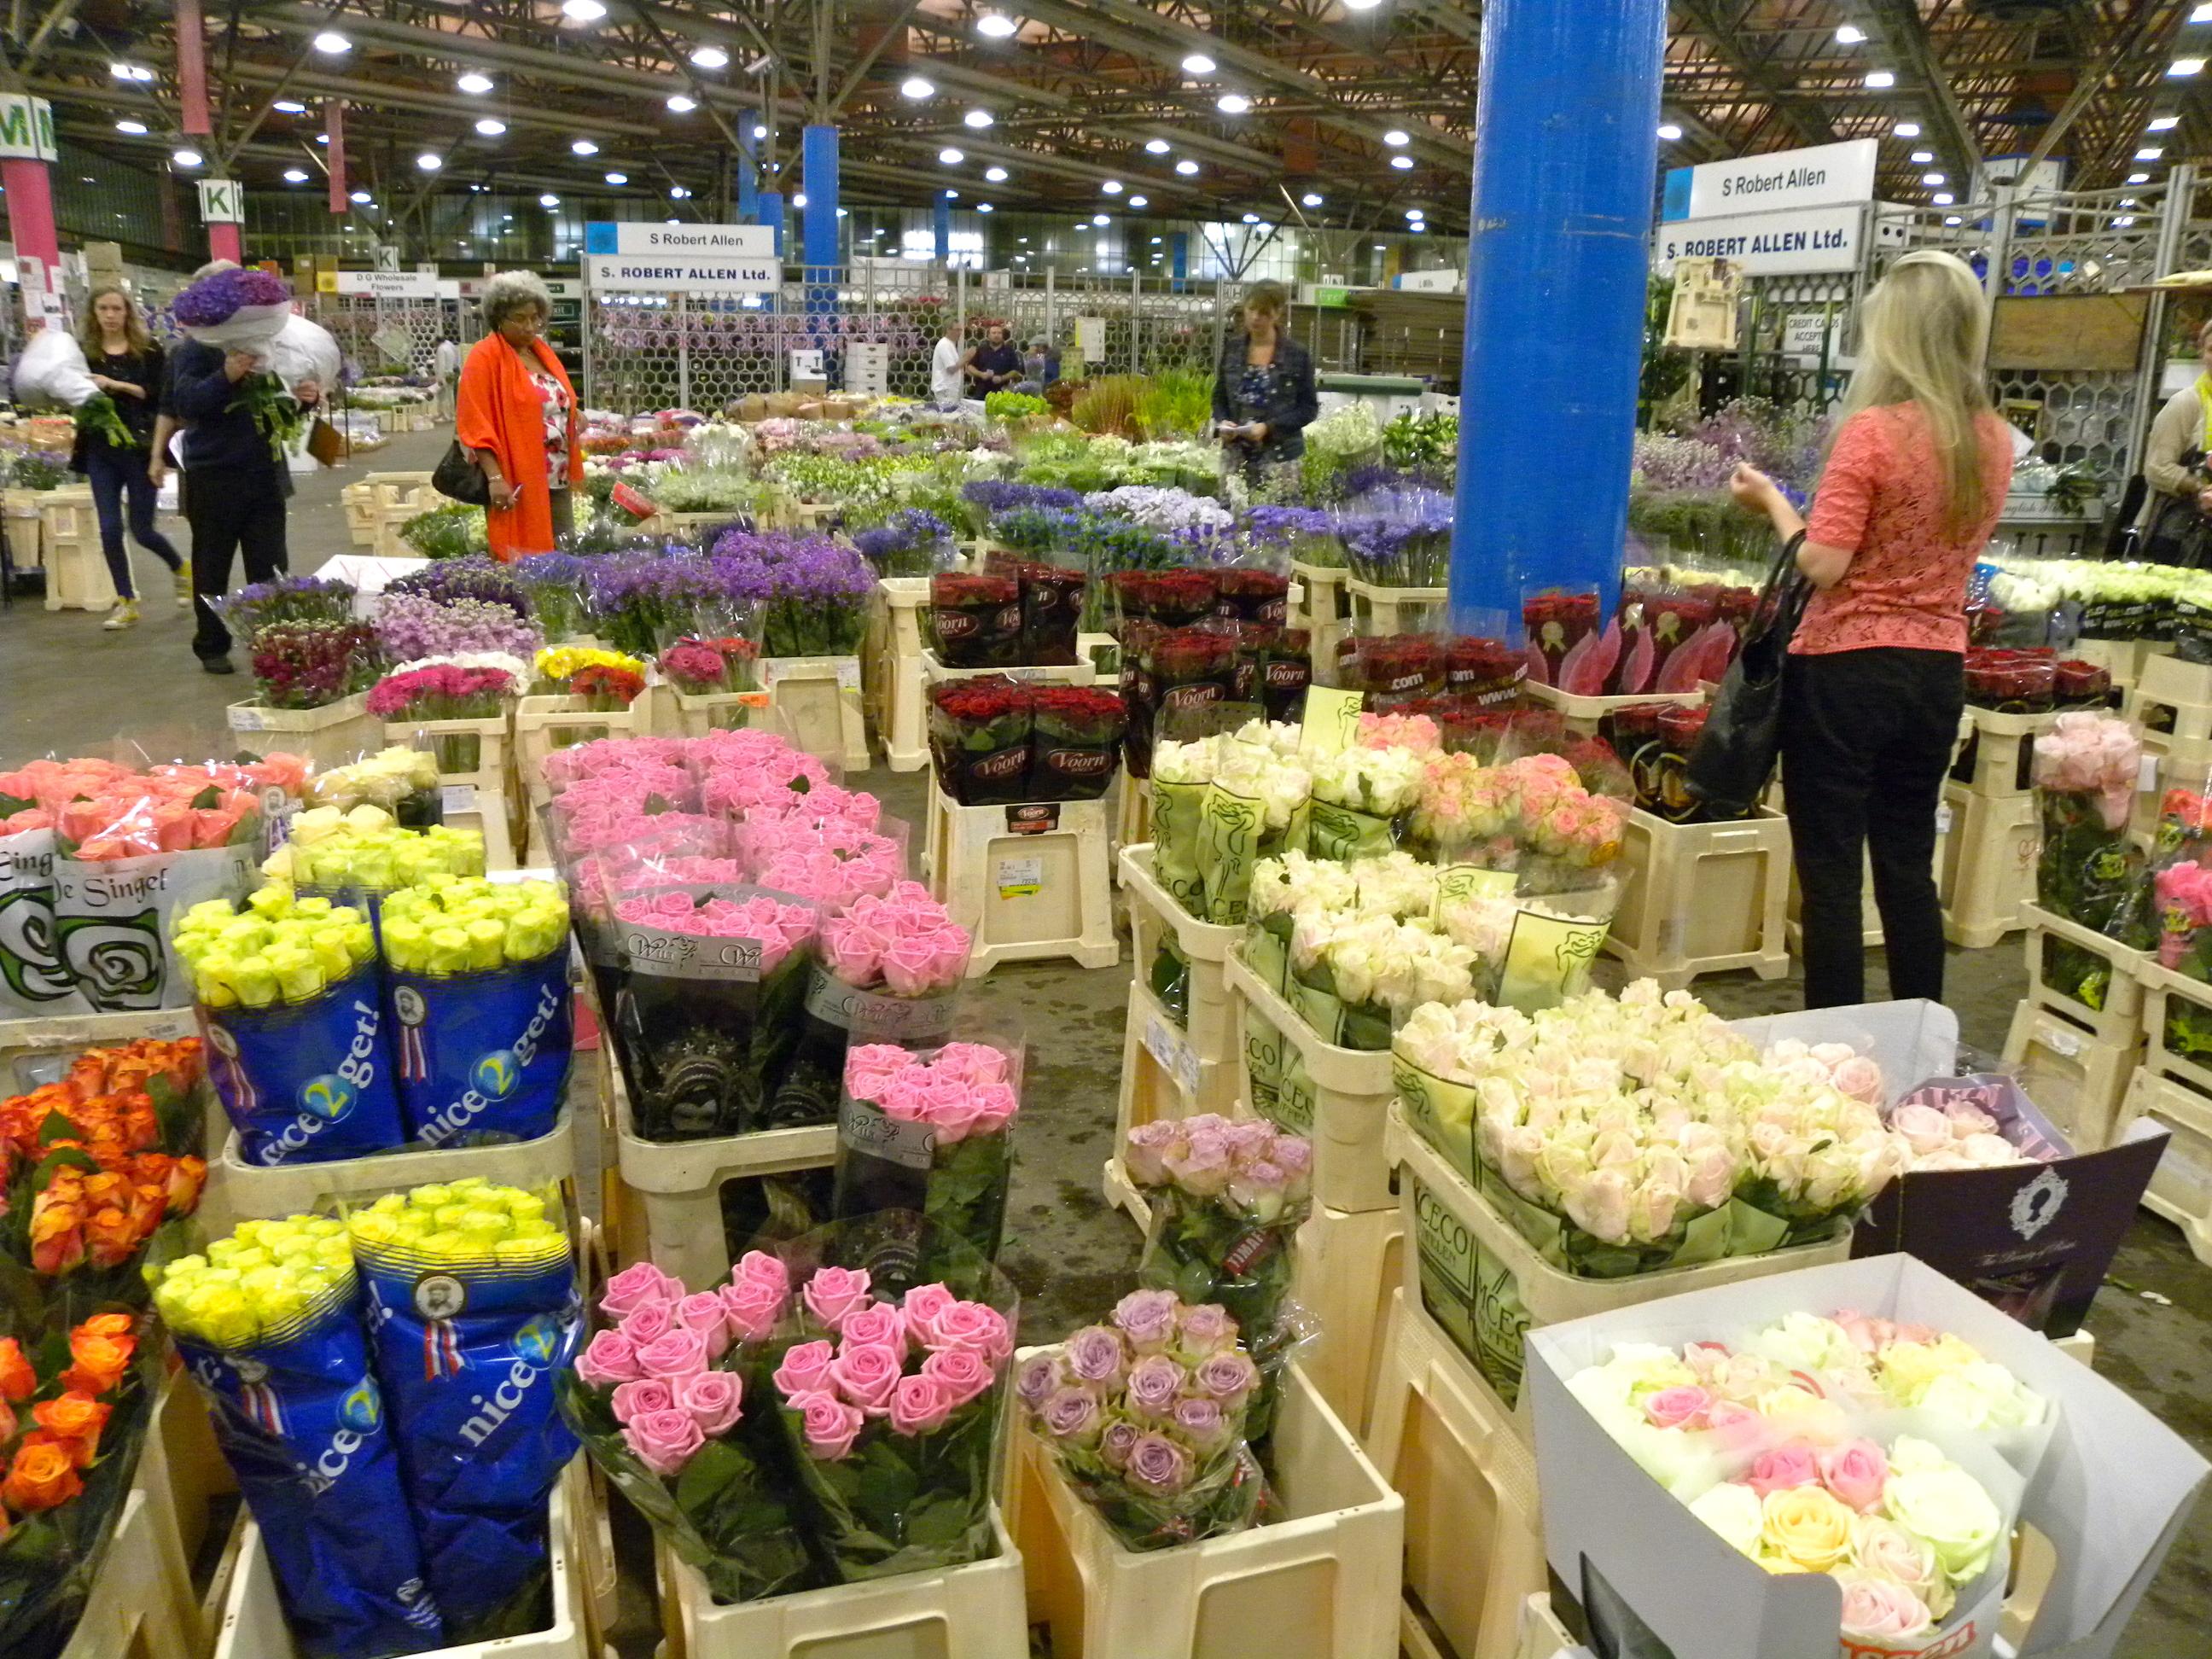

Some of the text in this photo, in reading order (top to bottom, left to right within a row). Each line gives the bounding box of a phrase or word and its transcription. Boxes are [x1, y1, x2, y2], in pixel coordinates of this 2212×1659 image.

[1722, 168, 1825, 196] S Robert Allen
[205, 186, 230, 214] K
[649, 233, 743, 246] S Robert Allen
[1667, 229, 1848, 260] S. ROBERT ALLEN Ltd.
[375, 273, 417, 282] Wholesale
[601, 266, 771, 281] S. ROBERT ALLEN Ltd.
[370, 283, 405, 292] Flowers
[1266, 665, 1305, 681] Voorn
[1173, 686, 1216, 707] Voorn
[982, 749, 1026, 775] Voorn
[1058, 751, 1105, 768] Voorn
[84, 867, 169, 907] Singel
[304, 1083, 349, 1118] 2
[338, 999, 381, 1089] get!
[417, 982, 558, 1147] nice 2 get!
[459, 1360, 537, 1447] nice
